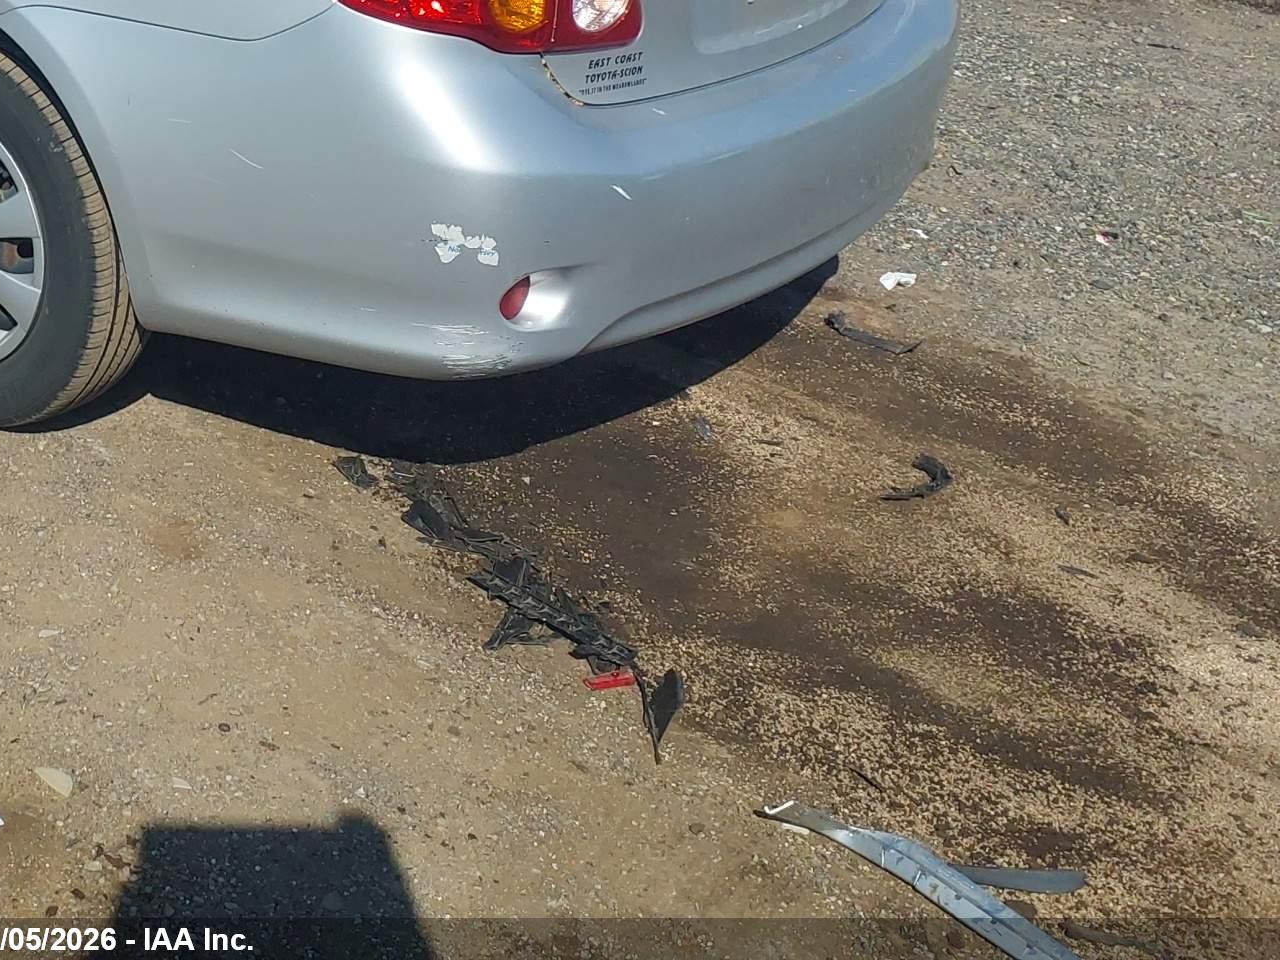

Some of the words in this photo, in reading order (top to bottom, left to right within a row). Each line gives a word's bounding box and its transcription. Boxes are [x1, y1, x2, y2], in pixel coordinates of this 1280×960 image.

[588, 57, 611, 69] EAST
[615, 52, 643, 64] COAST
[585, 65, 644, 84] TOYOTA-SCION
